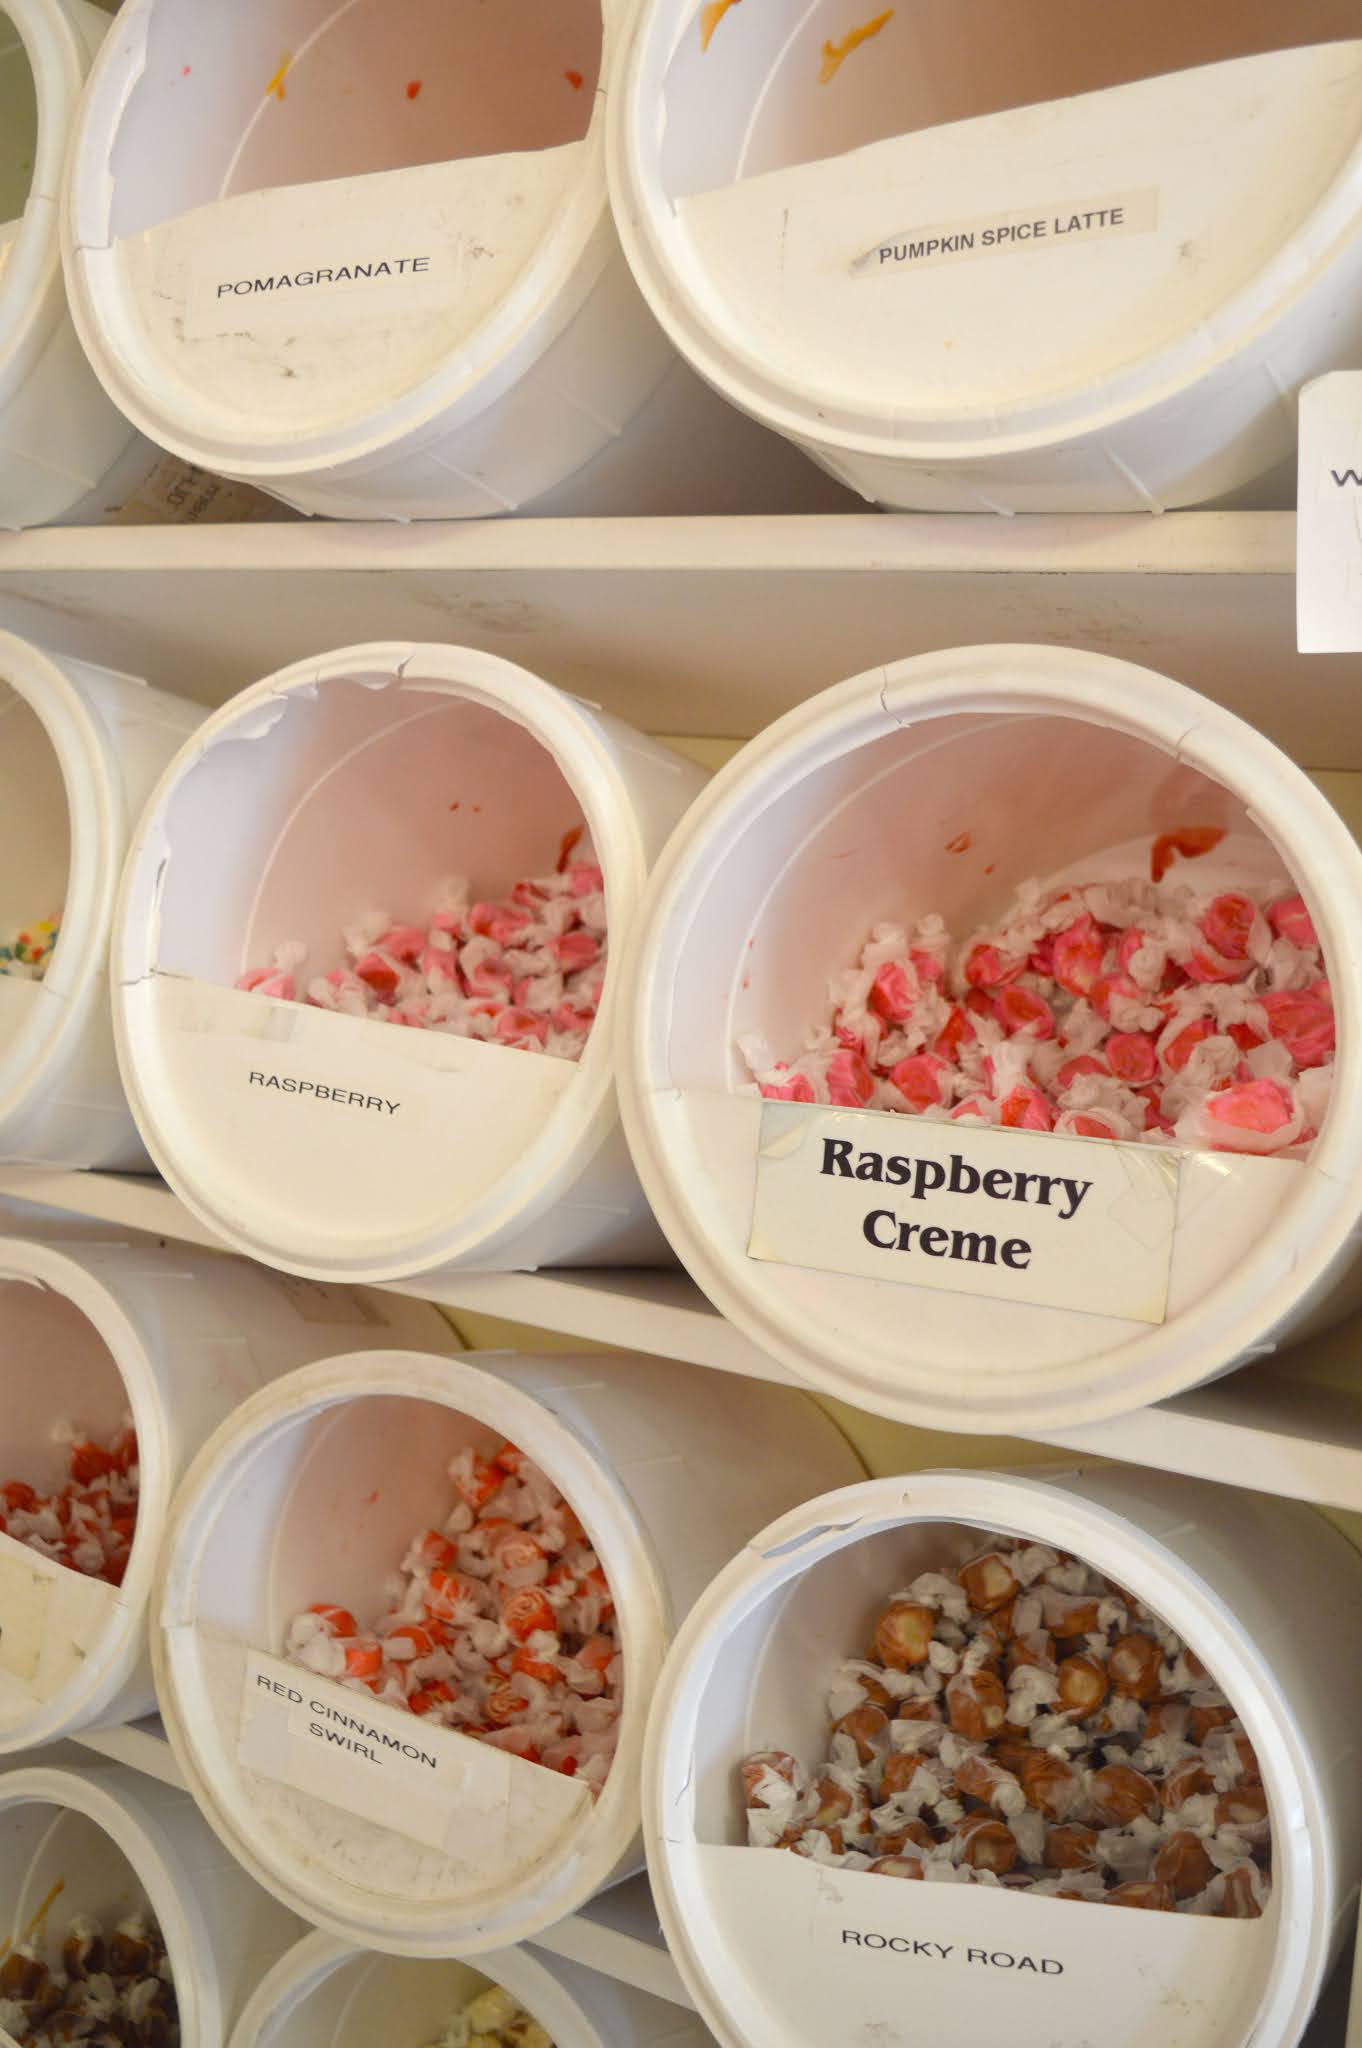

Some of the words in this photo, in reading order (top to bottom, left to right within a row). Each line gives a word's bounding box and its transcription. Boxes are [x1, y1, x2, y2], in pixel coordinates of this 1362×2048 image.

[879, 232, 975, 264] PUMPKIN
[981, 220, 1047, 247] SPICE
[1054, 207, 1124, 235] LATTE
[217, 257, 431, 298] POMAGRANATE
[249, 1071, 401, 1115] RASPBERRY
[819, 1137, 1094, 1219] Raspberry
[862, 1209, 1033, 1270] Creme
[256, 1674, 303, 1704] RED
[309, 1700, 437, 1768] CINNAMON
[309, 1722, 383, 1765] SWIRL
[841, 1930, 954, 1959] ROCKY
[967, 1948, 1065, 1975] ROAD
